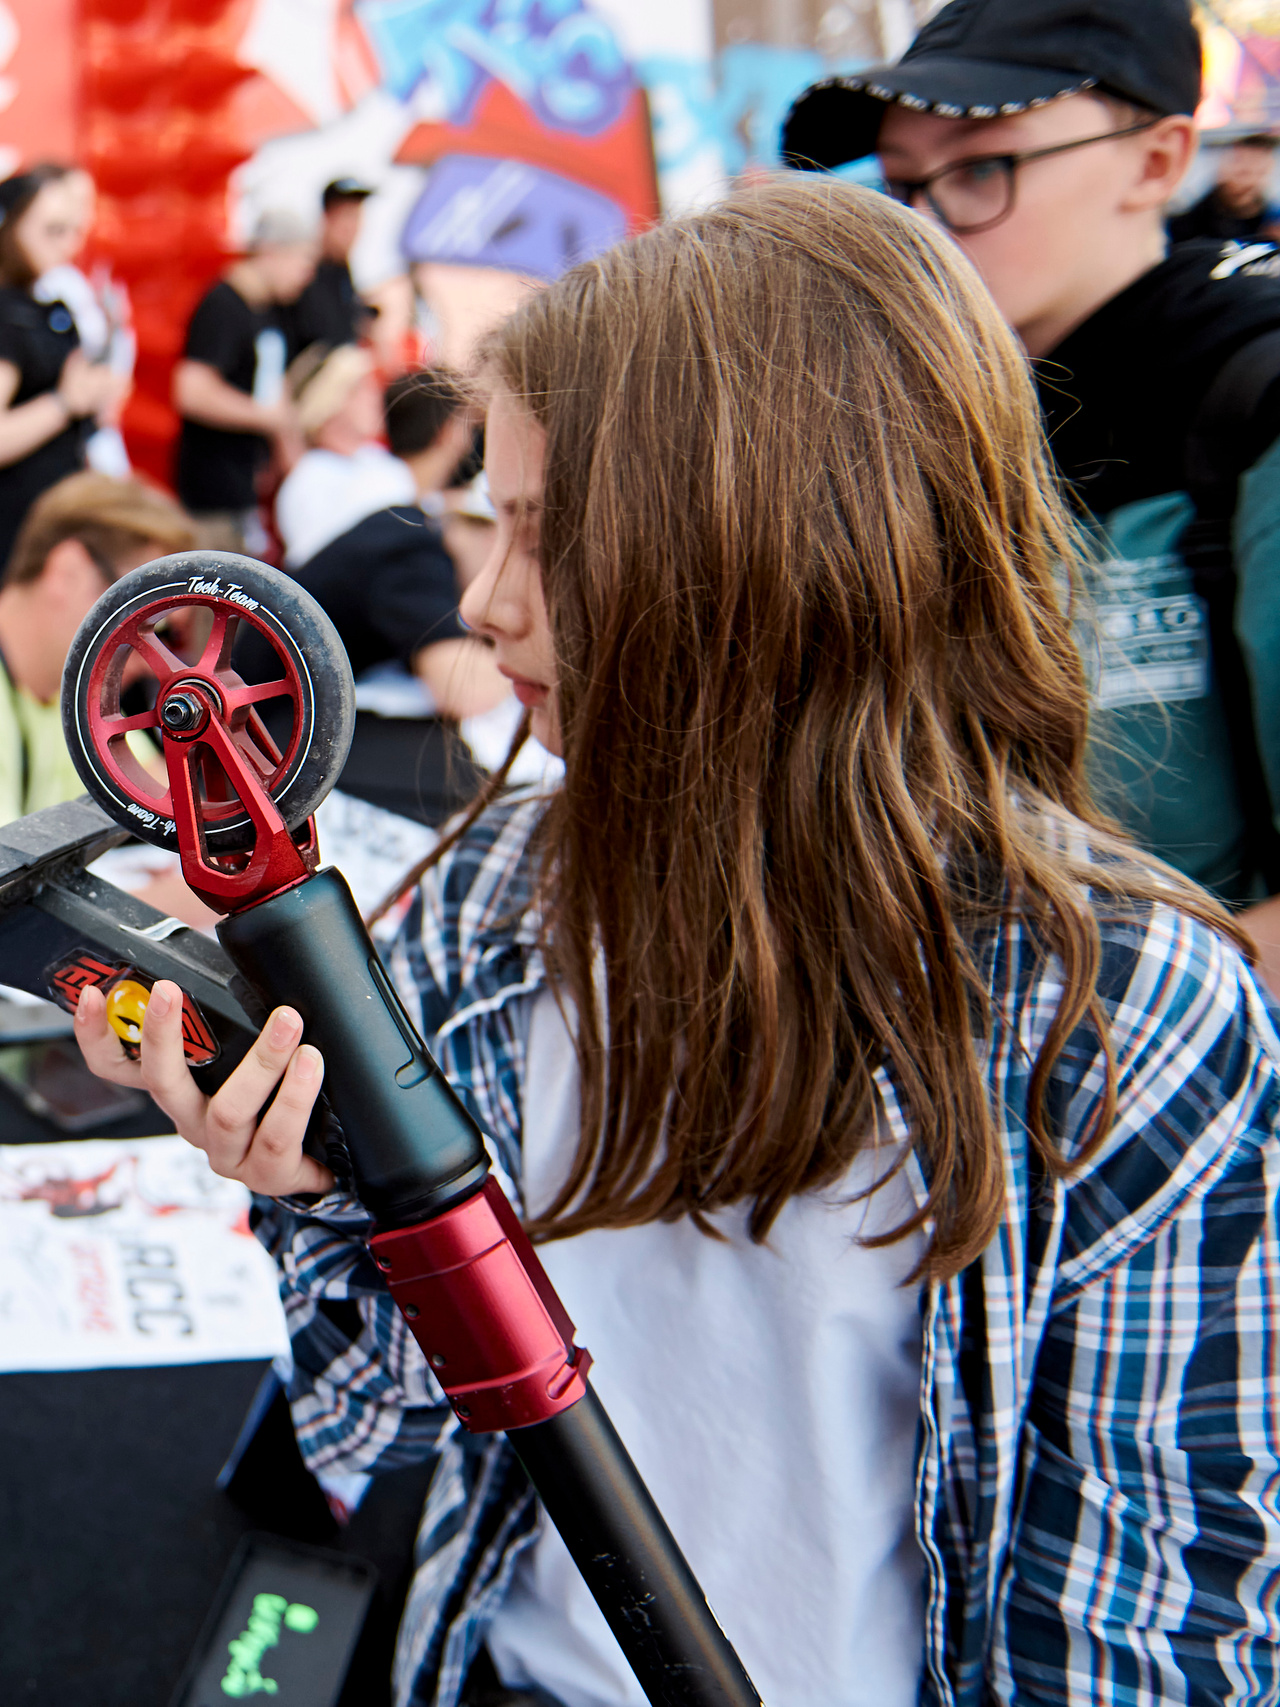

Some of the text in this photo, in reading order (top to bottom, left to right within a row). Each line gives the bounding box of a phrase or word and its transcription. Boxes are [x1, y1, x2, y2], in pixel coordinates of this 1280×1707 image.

[187, 575, 260, 611] Tech-Team
[126, 803, 178, 837] h-Team
[53, 956, 124, 1014] TEA
[120, 1243, 195, 1337] RCC
